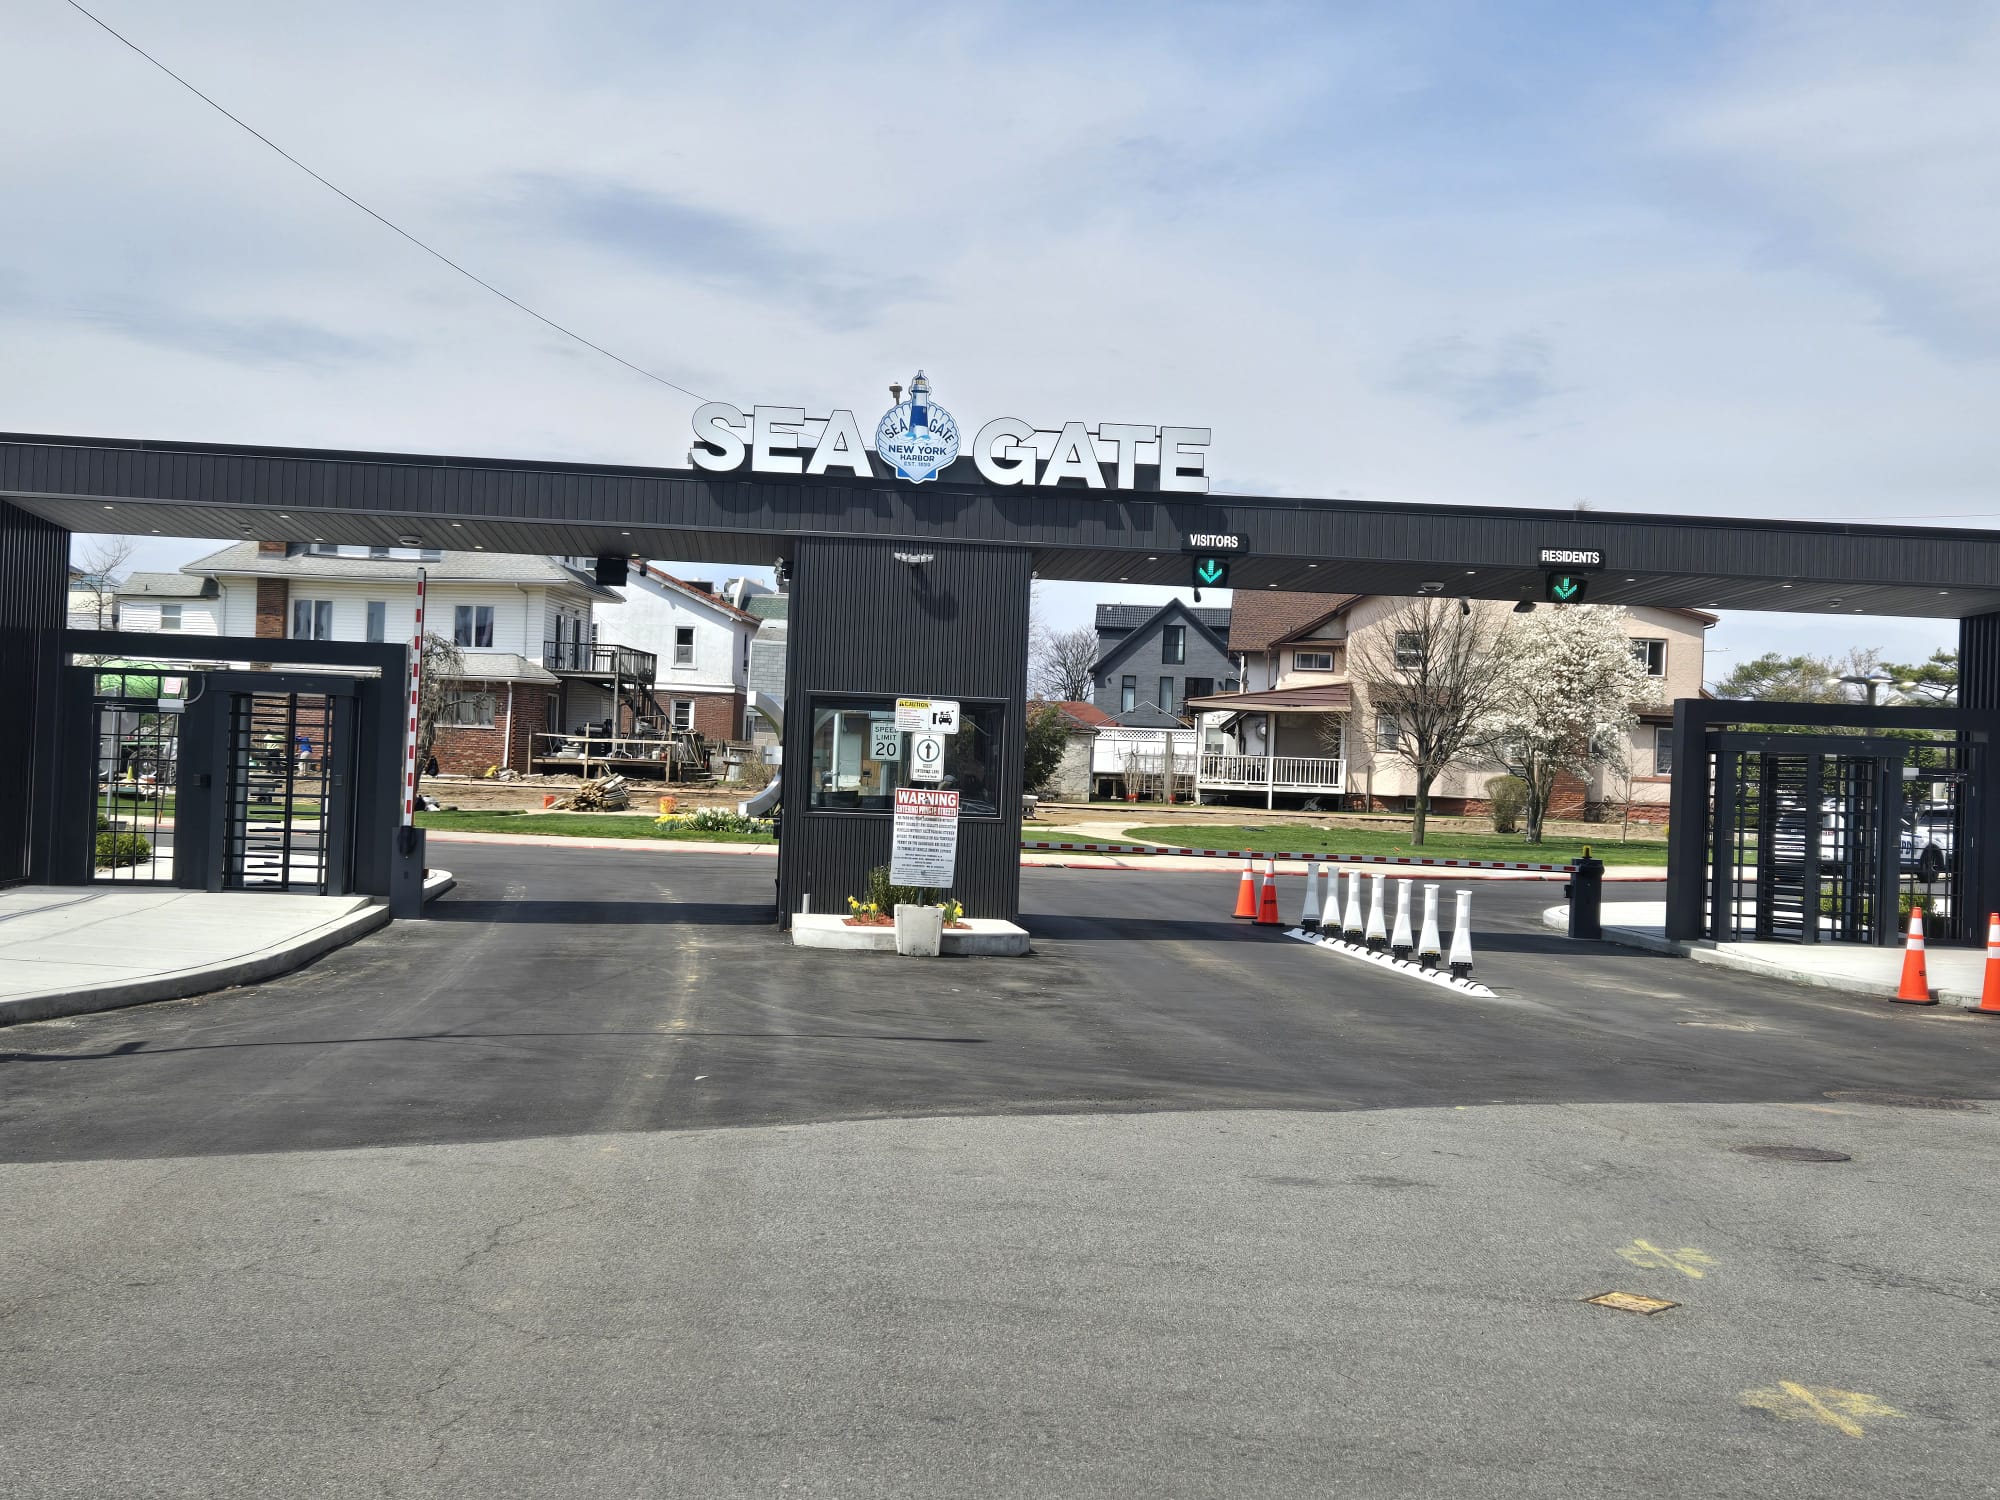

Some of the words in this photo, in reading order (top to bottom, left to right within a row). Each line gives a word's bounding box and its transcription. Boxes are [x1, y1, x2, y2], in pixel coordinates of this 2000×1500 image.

[885, 418, 908, 438] SEA
[929, 419, 954, 443] GATE
[690, 402, 874, 478] SEA
[973, 417, 1211, 493] GATE
[888, 445, 914, 454] NEW
[918, 447, 946, 455] YORK
[1189, 533, 1239, 548] VISITORS
[1541, 549, 1600, 564] RESIDENTS
[875, 742, 897, 756] 20
[898, 791, 957, 807] WARNING
